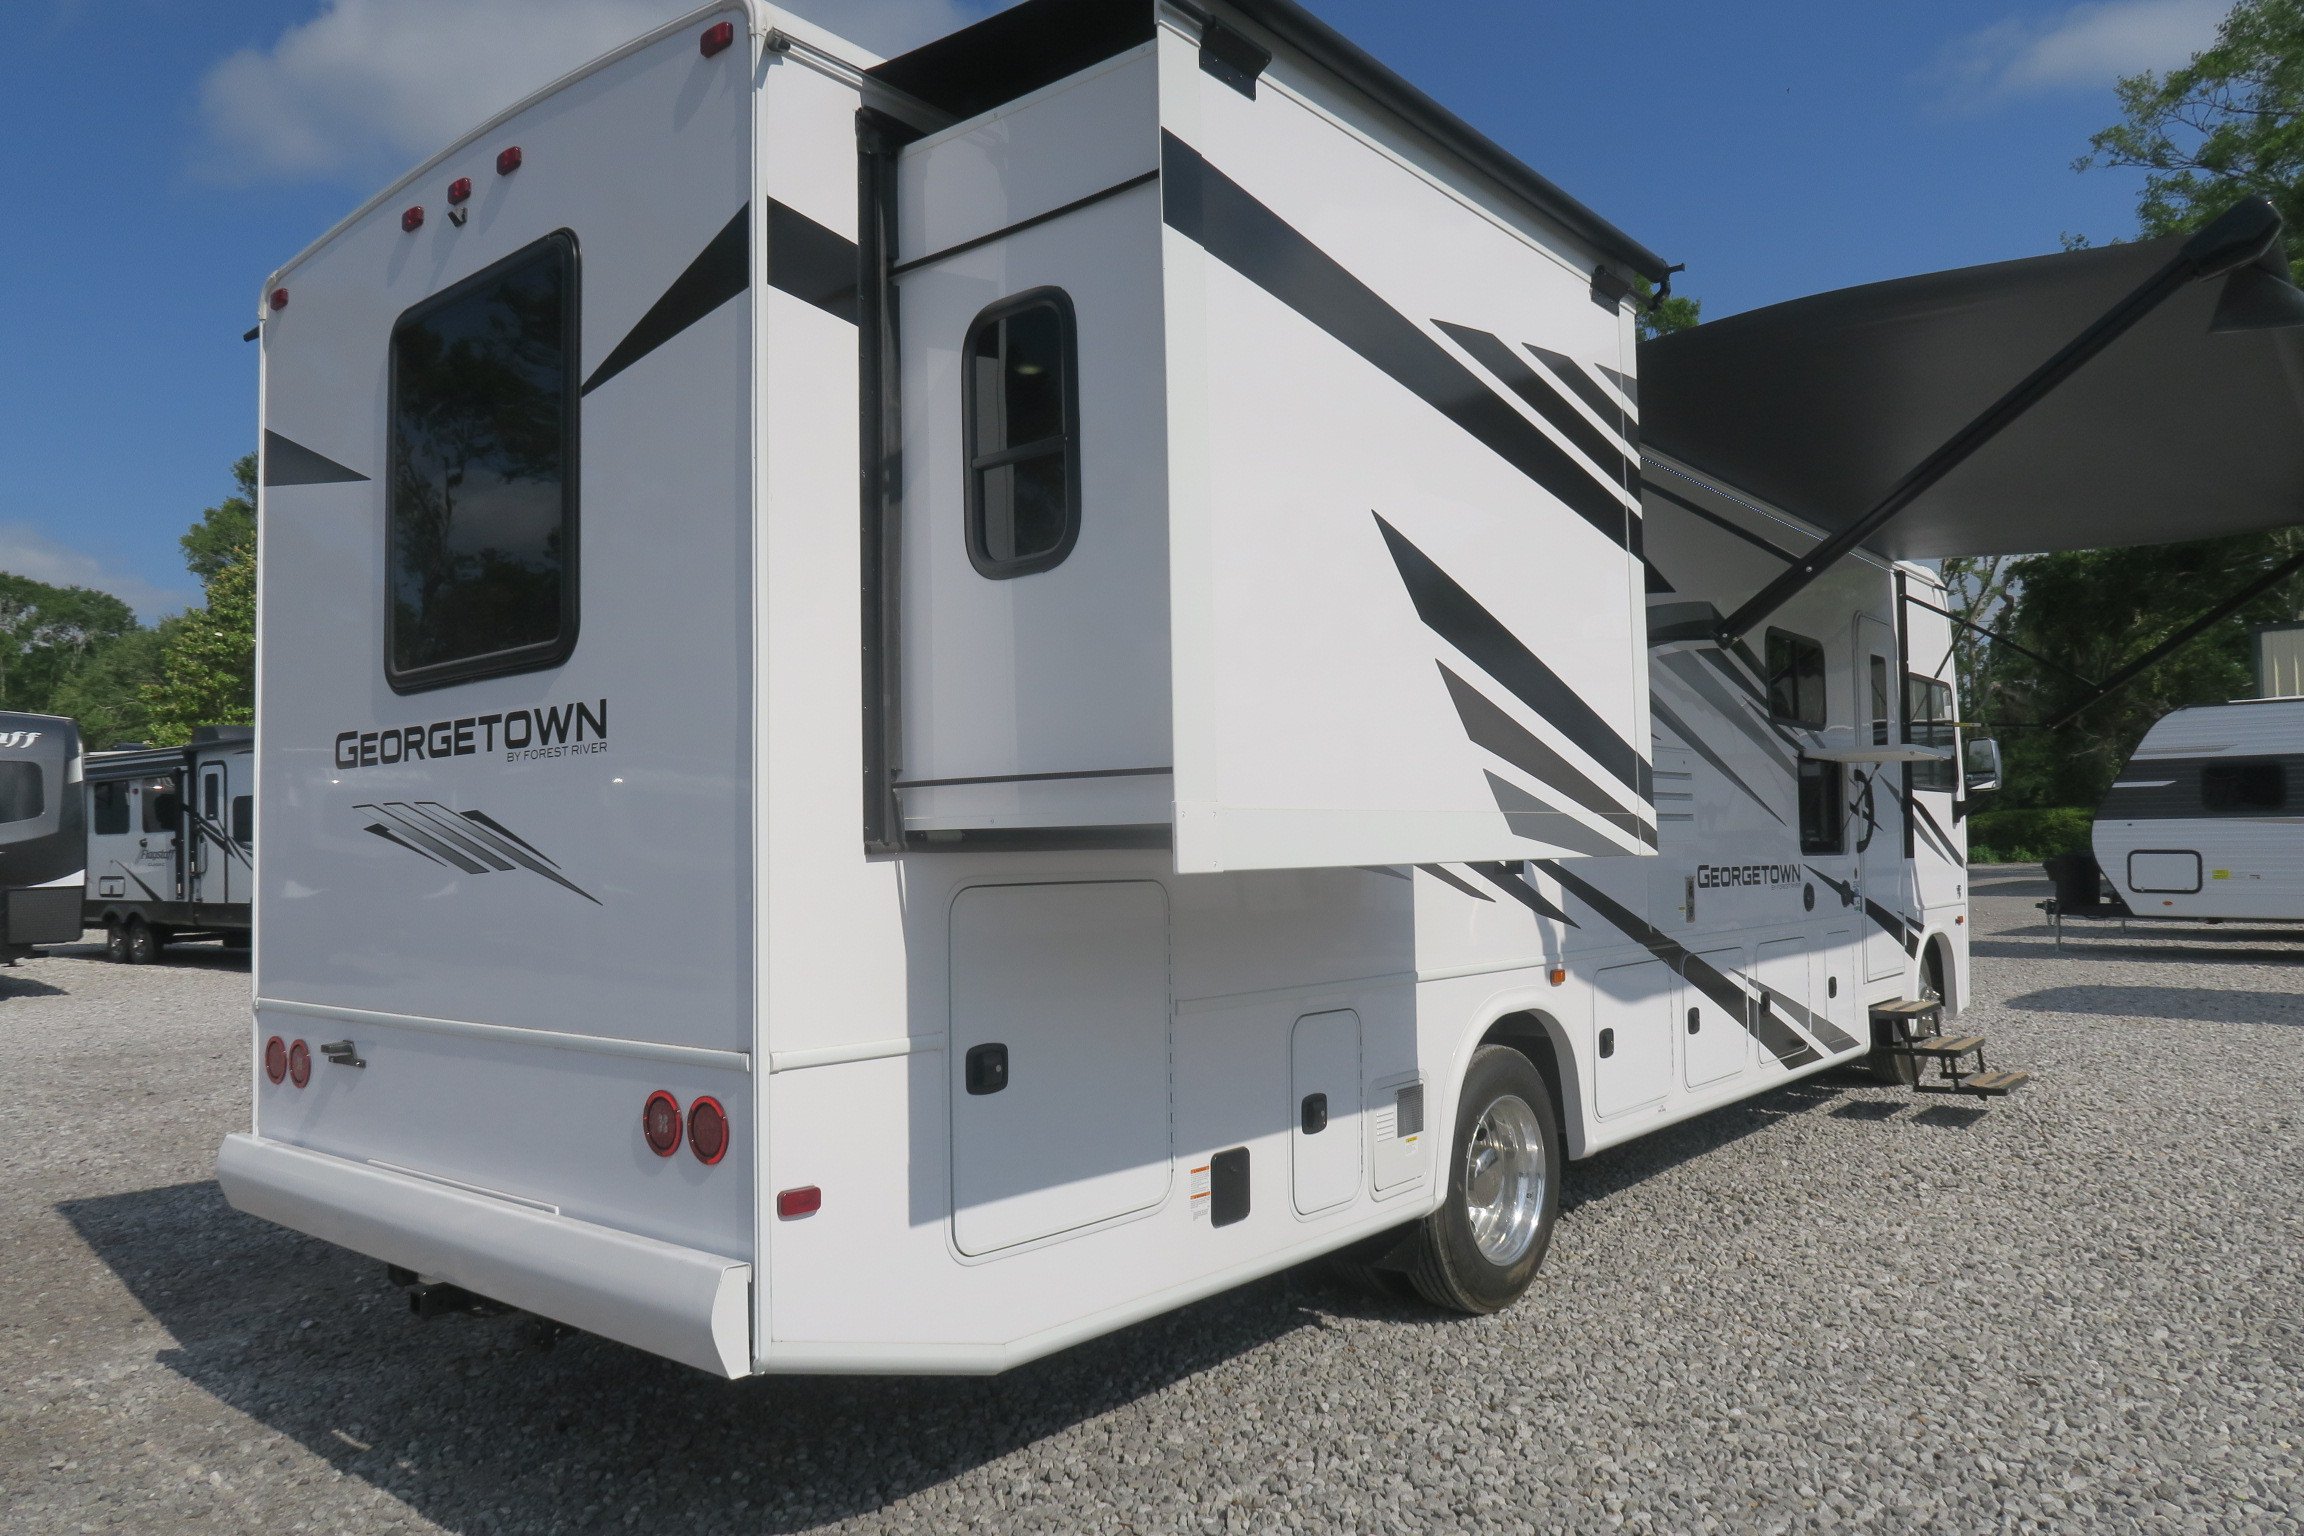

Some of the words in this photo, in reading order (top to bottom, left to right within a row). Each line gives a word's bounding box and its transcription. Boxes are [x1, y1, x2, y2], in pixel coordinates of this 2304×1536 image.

[335, 698, 608, 770] GEORGETOWN
[506, 752, 522, 763] BY
[523, 745, 569, 761] FOREST
[571, 741, 608, 756] RIVER
[1697, 863, 1801, 889] GEORGETOWN
